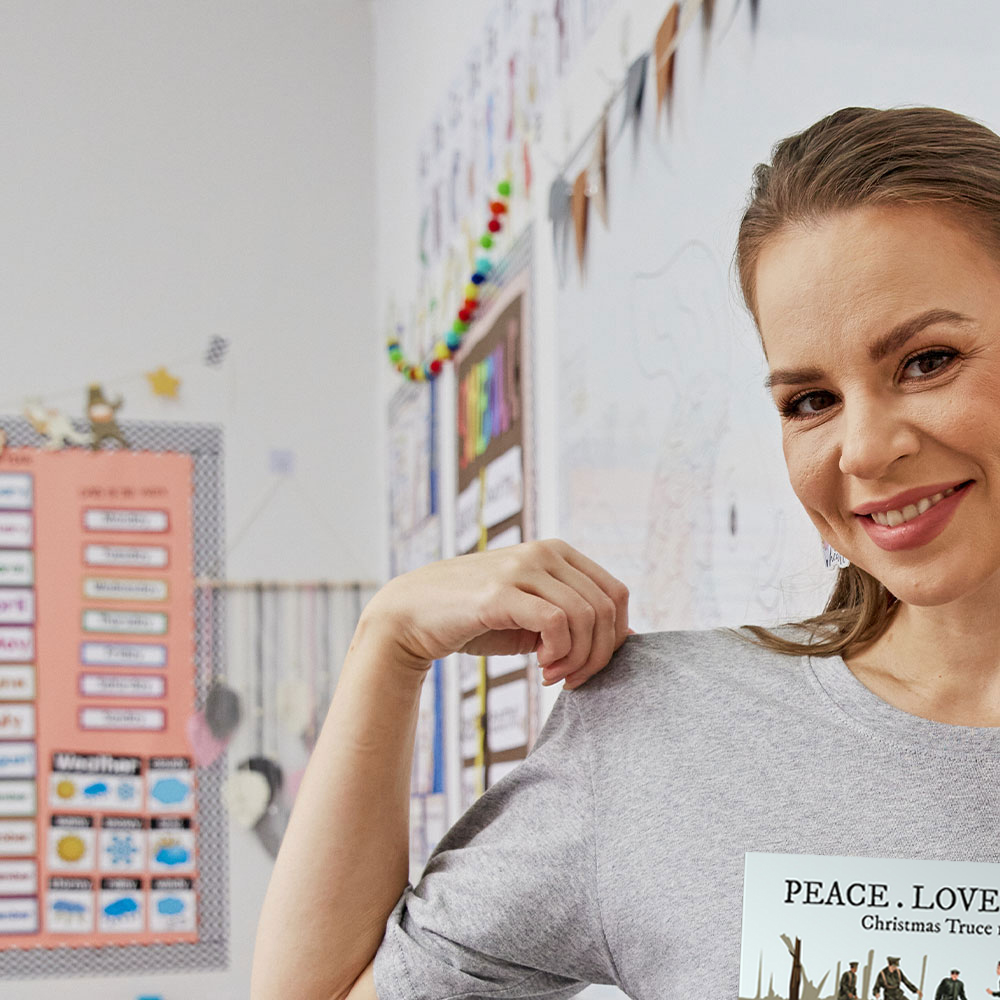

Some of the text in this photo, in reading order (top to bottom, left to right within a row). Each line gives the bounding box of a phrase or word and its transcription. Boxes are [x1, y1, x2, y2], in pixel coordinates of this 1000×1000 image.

[783, 879, 889, 907] PEACE
[911, 885, 1000, 913] LOVE
[861, 914, 941, 933] Christmas
[945, 918, 992, 935] Truce
